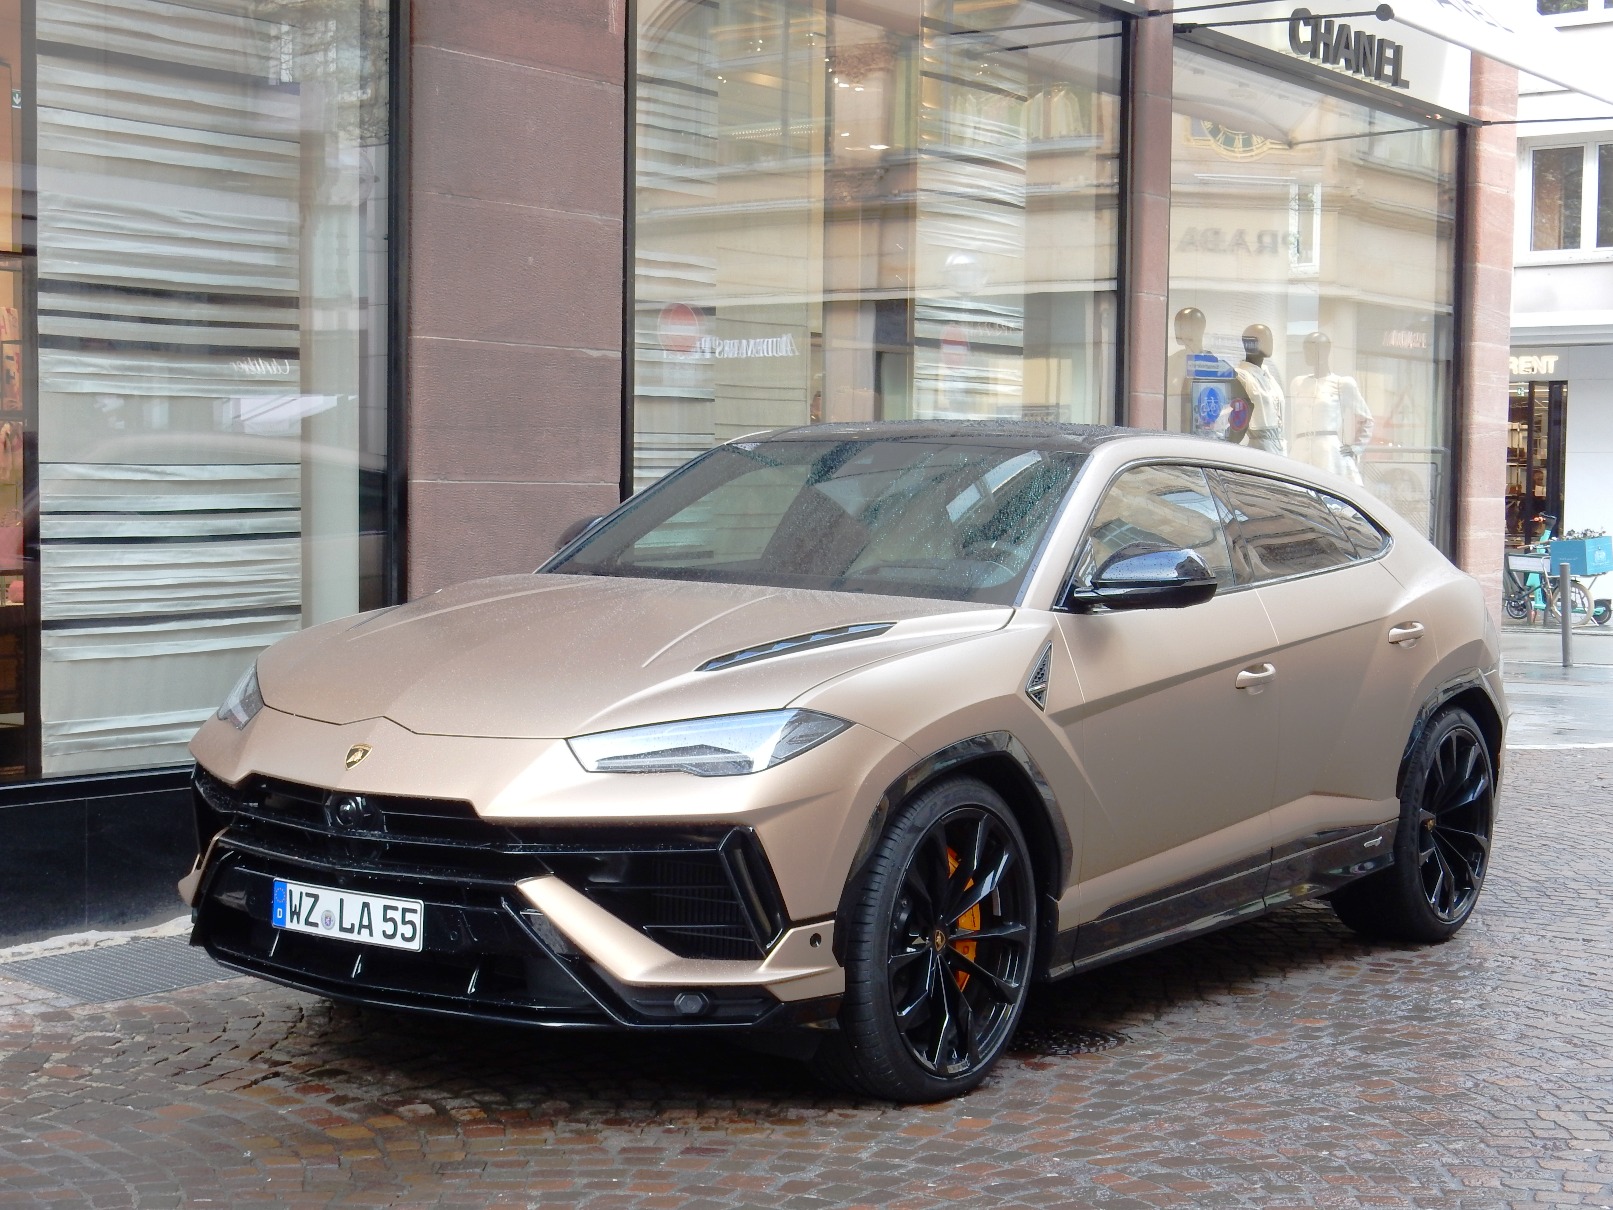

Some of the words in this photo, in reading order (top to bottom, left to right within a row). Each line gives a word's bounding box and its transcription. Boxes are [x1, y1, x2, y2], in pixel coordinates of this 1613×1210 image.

[1289, 7, 1410, 90] CHANEL
[276, 907, 283, 919] D
[288, 888, 320, 928] WZ
[338, 897, 374, 938] LA
[381, 904, 418, 943] 55
